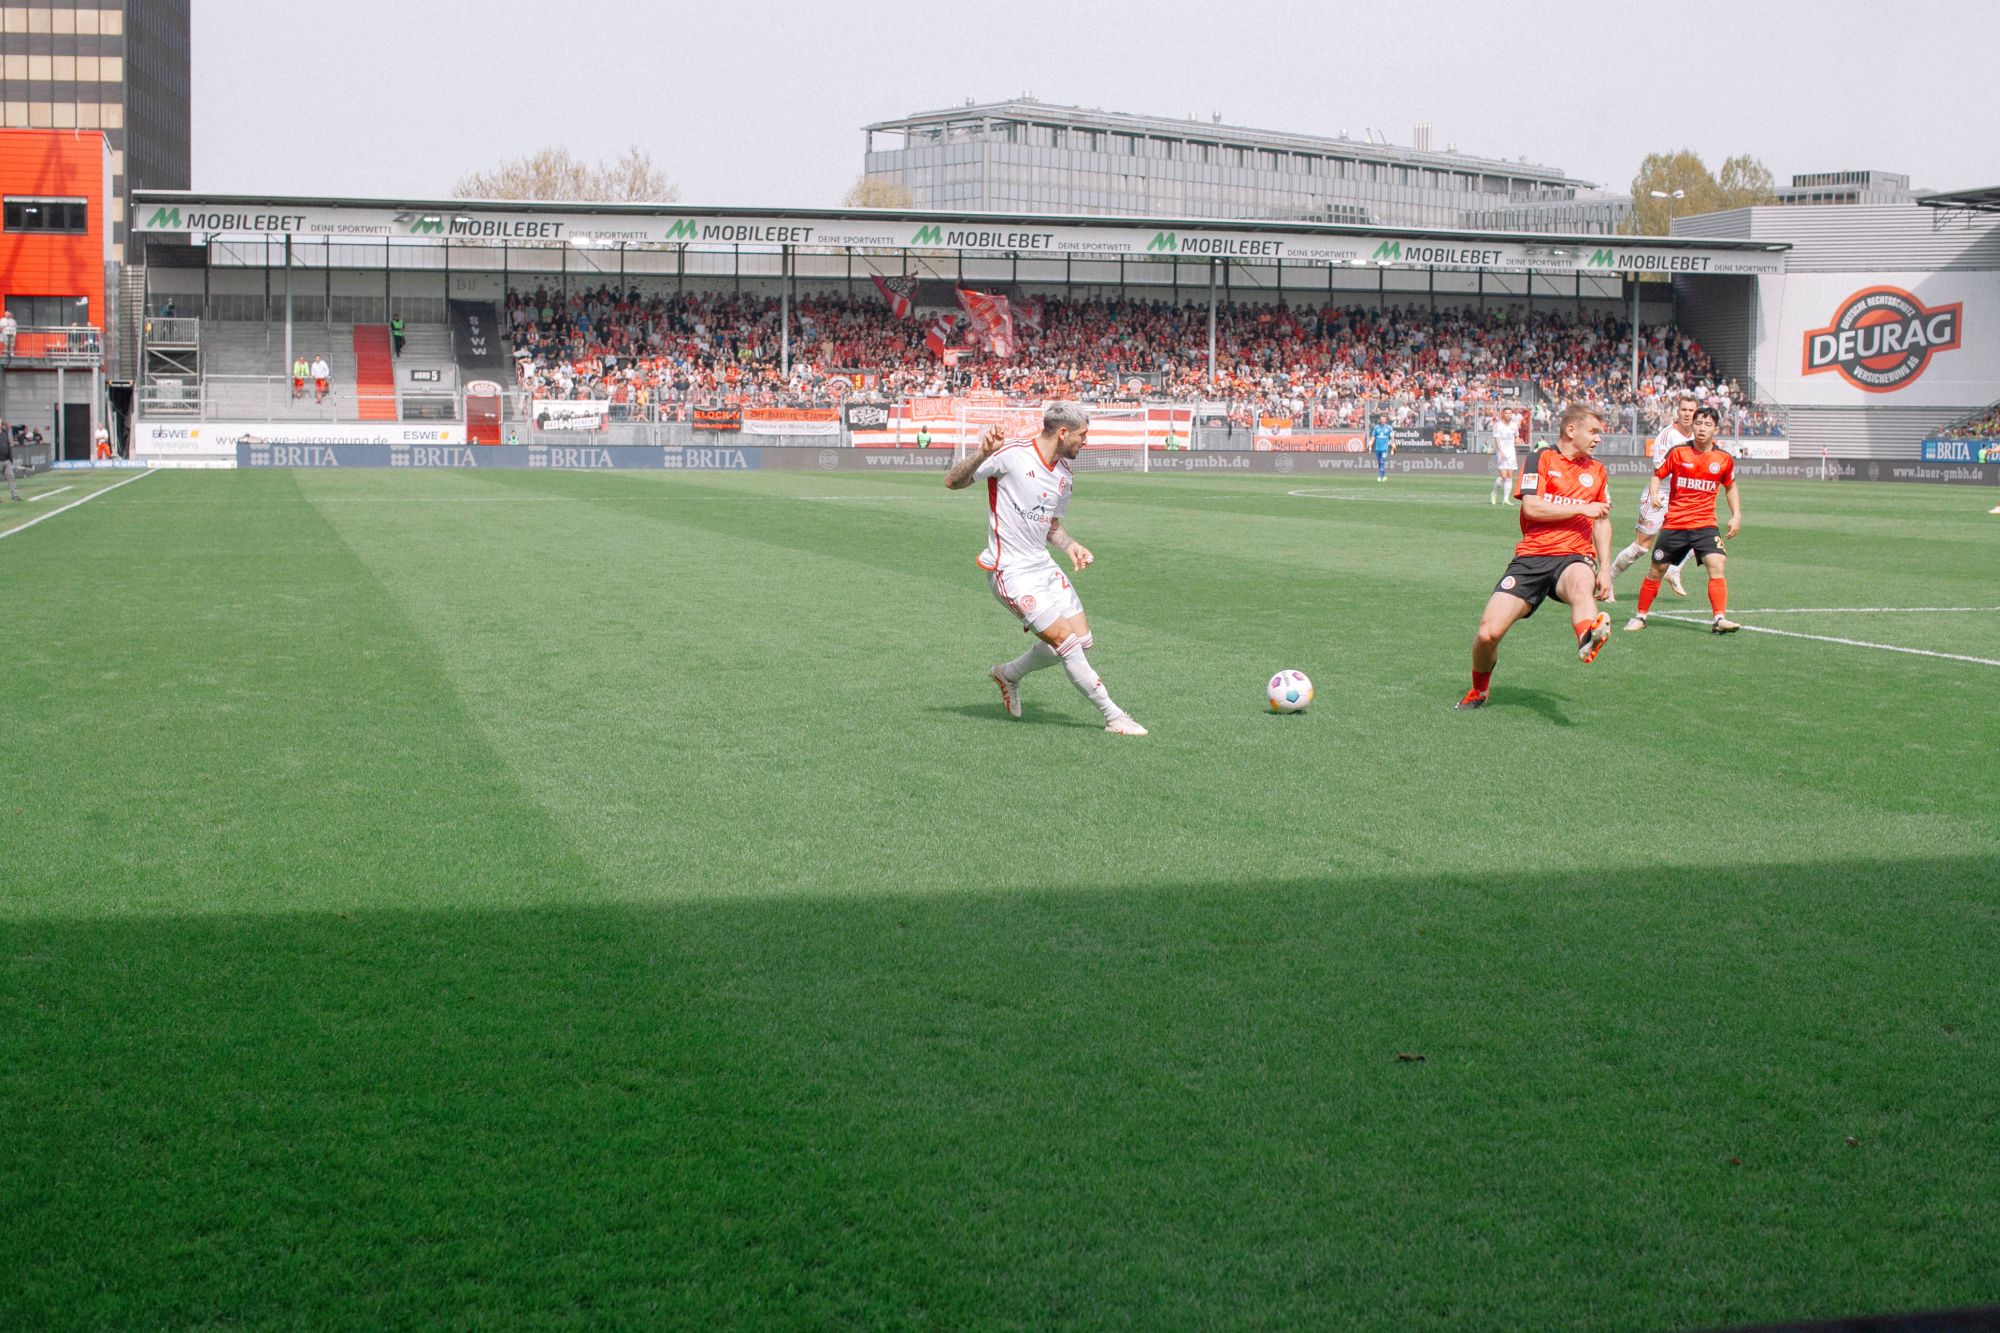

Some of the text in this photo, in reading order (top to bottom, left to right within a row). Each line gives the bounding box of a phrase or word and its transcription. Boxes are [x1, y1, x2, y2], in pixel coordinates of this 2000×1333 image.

[186, 213, 307, 231] MOBILEBET
[311, 224, 335, 233] DEINE
[337, 225, 393, 234] SPORTWETTE
[448, 220, 564, 238] MOBILEBET
[594, 231, 648, 240] SPORTWETTE
[702, 225, 814, 243] MOBILEBET
[818, 235, 841, 244] DEINE
[842, 236, 895, 245] SPORTWETTE
[947, 231, 1054, 249] MOBILEBET
[1058, 242, 1080, 250] DEINE
[1082, 242, 1131, 251] SPORTWETTE
[1181, 238, 1284, 255] MOBILEBET
[1287, 249, 1308, 257] DEINE
[1310, 250, 1357, 259] SPORTWETTE
[1405, 247, 1503, 265] MOBILEBET
[1506, 258, 1526, 266] DEINE
[1528, 258, 1573, 267] SPORTWETTE
[1618, 254, 1711, 271] MOBILEBET
[1714, 264, 1733, 272] DEINE
[1735, 265, 1778, 273] SPORTWETTE
[1867, 295, 1916, 318] RECHTSSCHUTZ
[1813, 314, 1952, 366] DEURAG
[431, 371, 438, 381] 5
[1853, 364, 1910, 384] VERSICHERUNG
[152, 429, 188, 439] ESWE
[403, 431, 438, 440] ESWE
[273, 447, 339, 466] BRITA
[413, 447, 478, 467] BRITA
[551, 448, 614, 468] BRITA
[686, 448, 748, 468] BRITA
[1937, 442, 1970, 460] BRITA
[1893, 466, 1983, 481] www.lauer-gmbh.de
[1687, 478, 1716, 491] BRITA
[1554, 495, 1587, 505] BRIT
